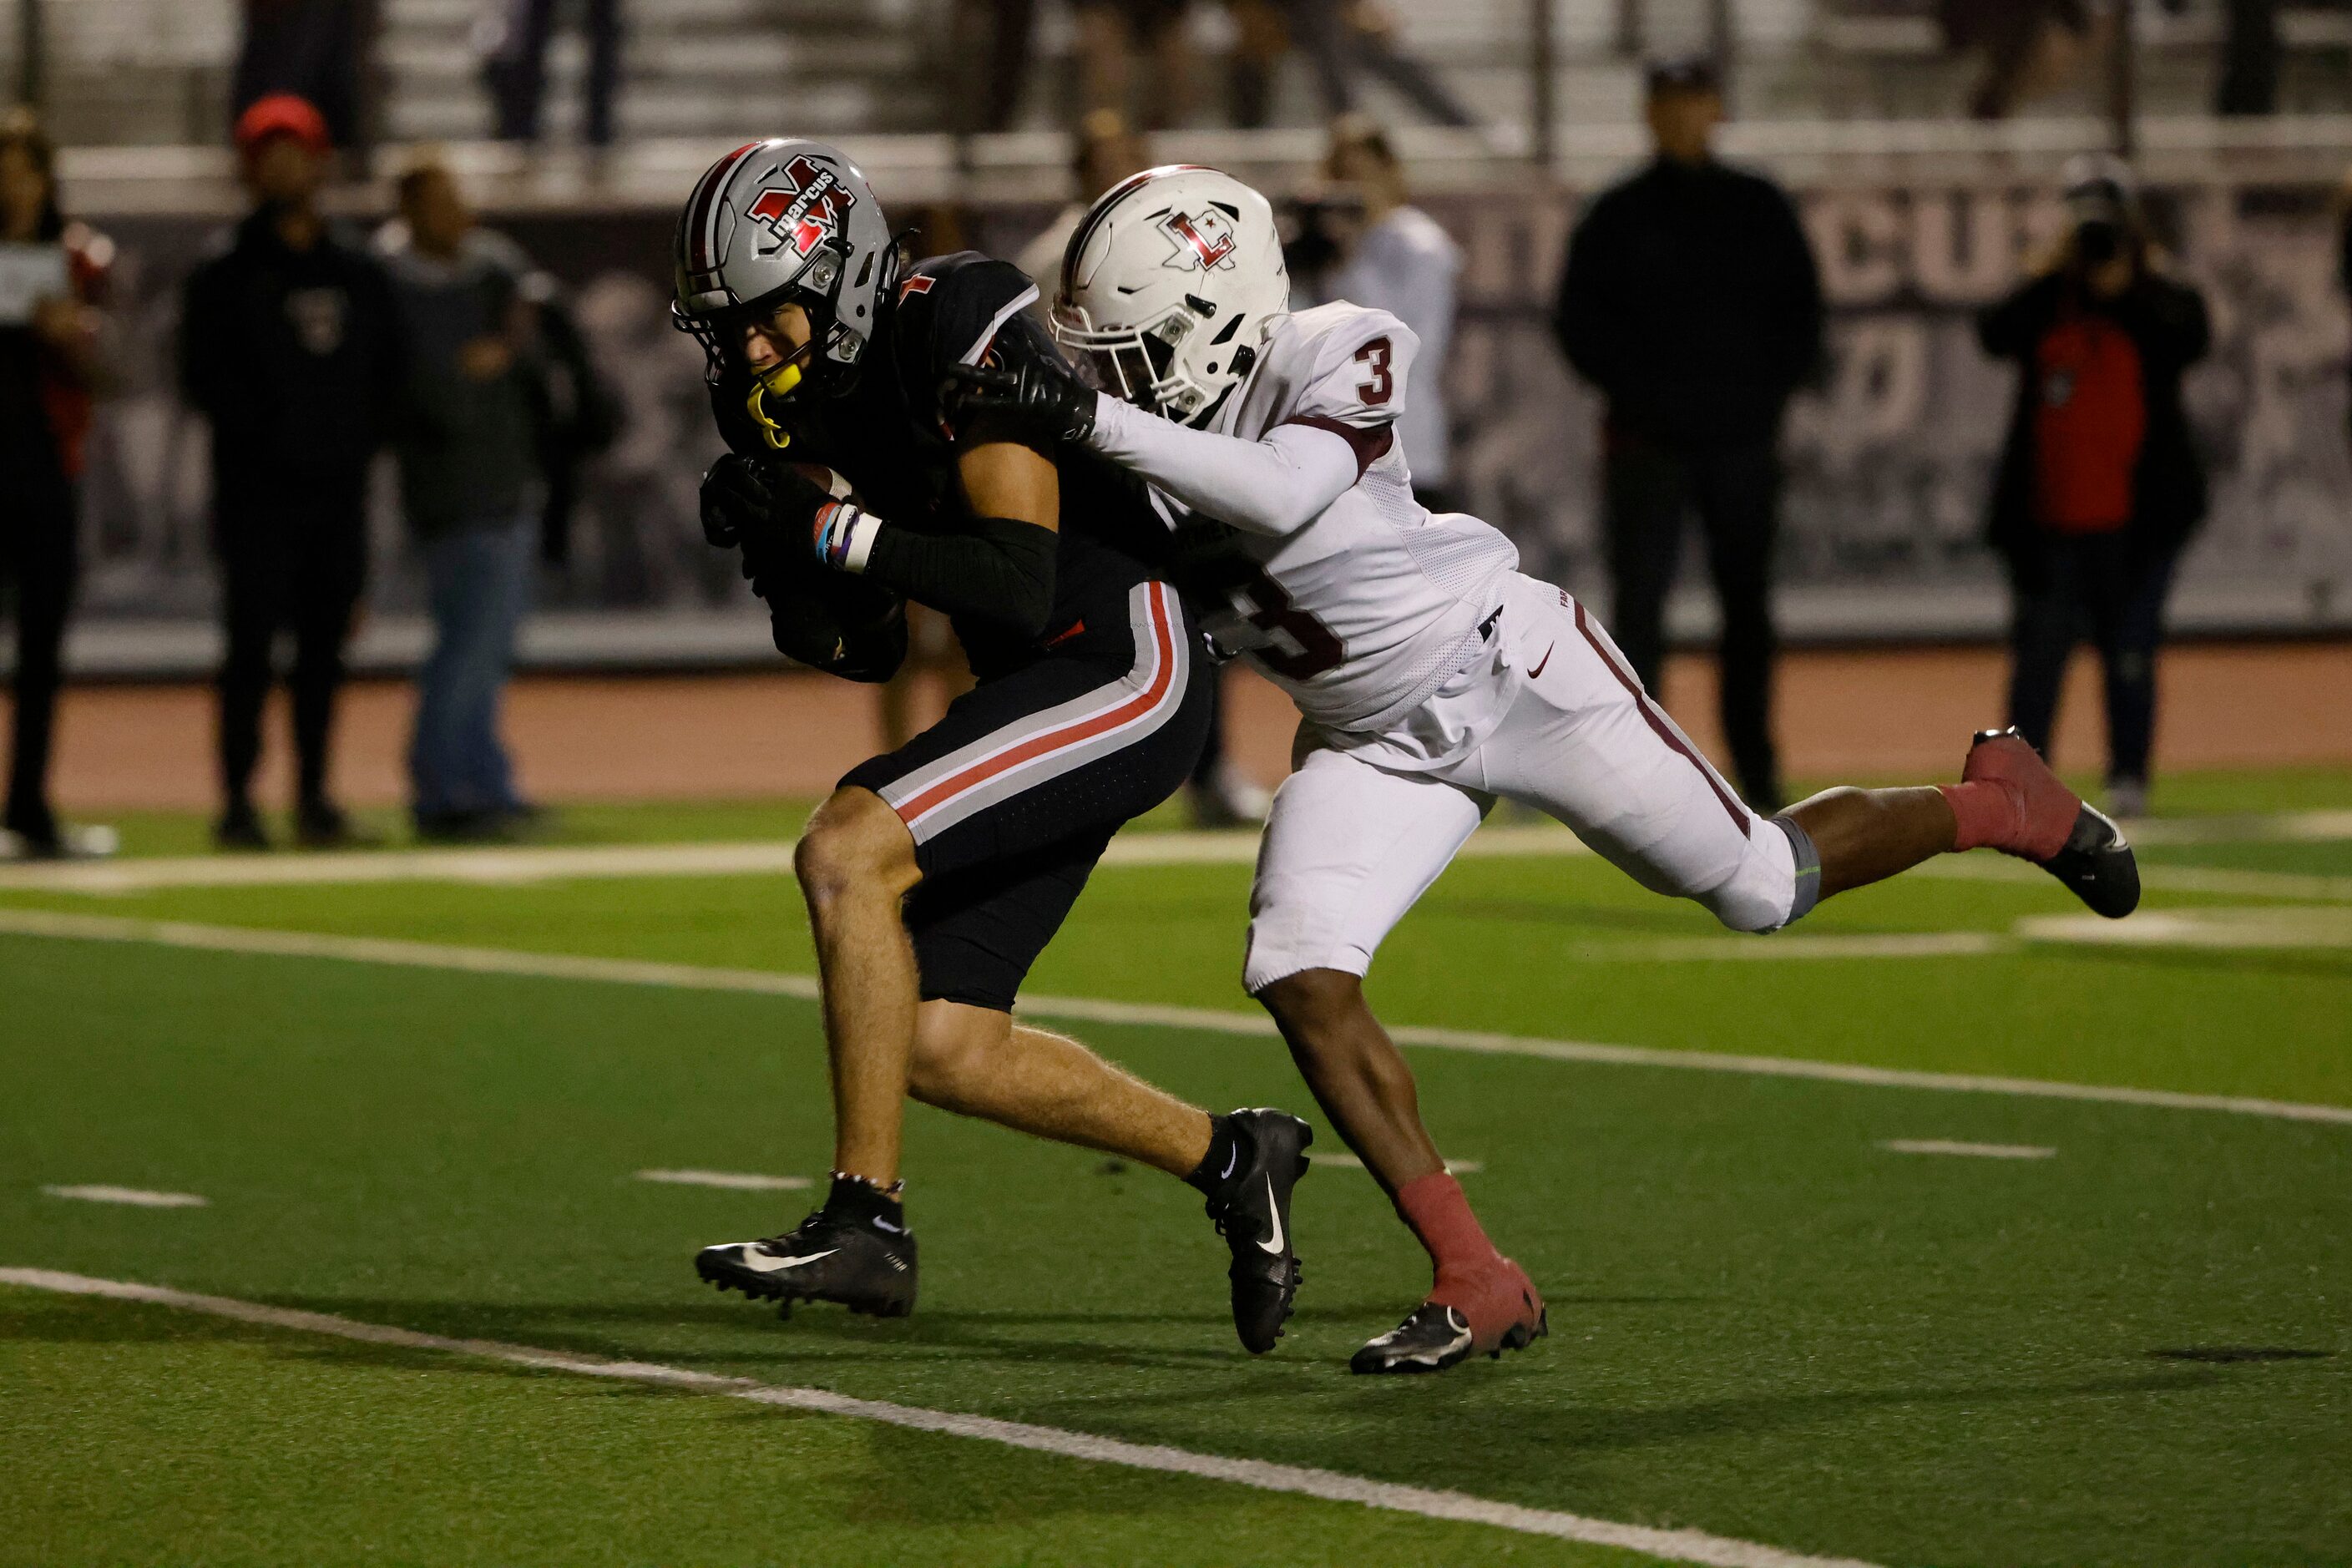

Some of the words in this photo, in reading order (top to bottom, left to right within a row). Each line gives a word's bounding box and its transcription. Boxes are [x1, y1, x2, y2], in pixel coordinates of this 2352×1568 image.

[773, 171, 834, 237] marcus
[1166, 211, 1236, 271] L
[1352, 334, 1393, 409] 3
[1189, 559, 1343, 681] 3
